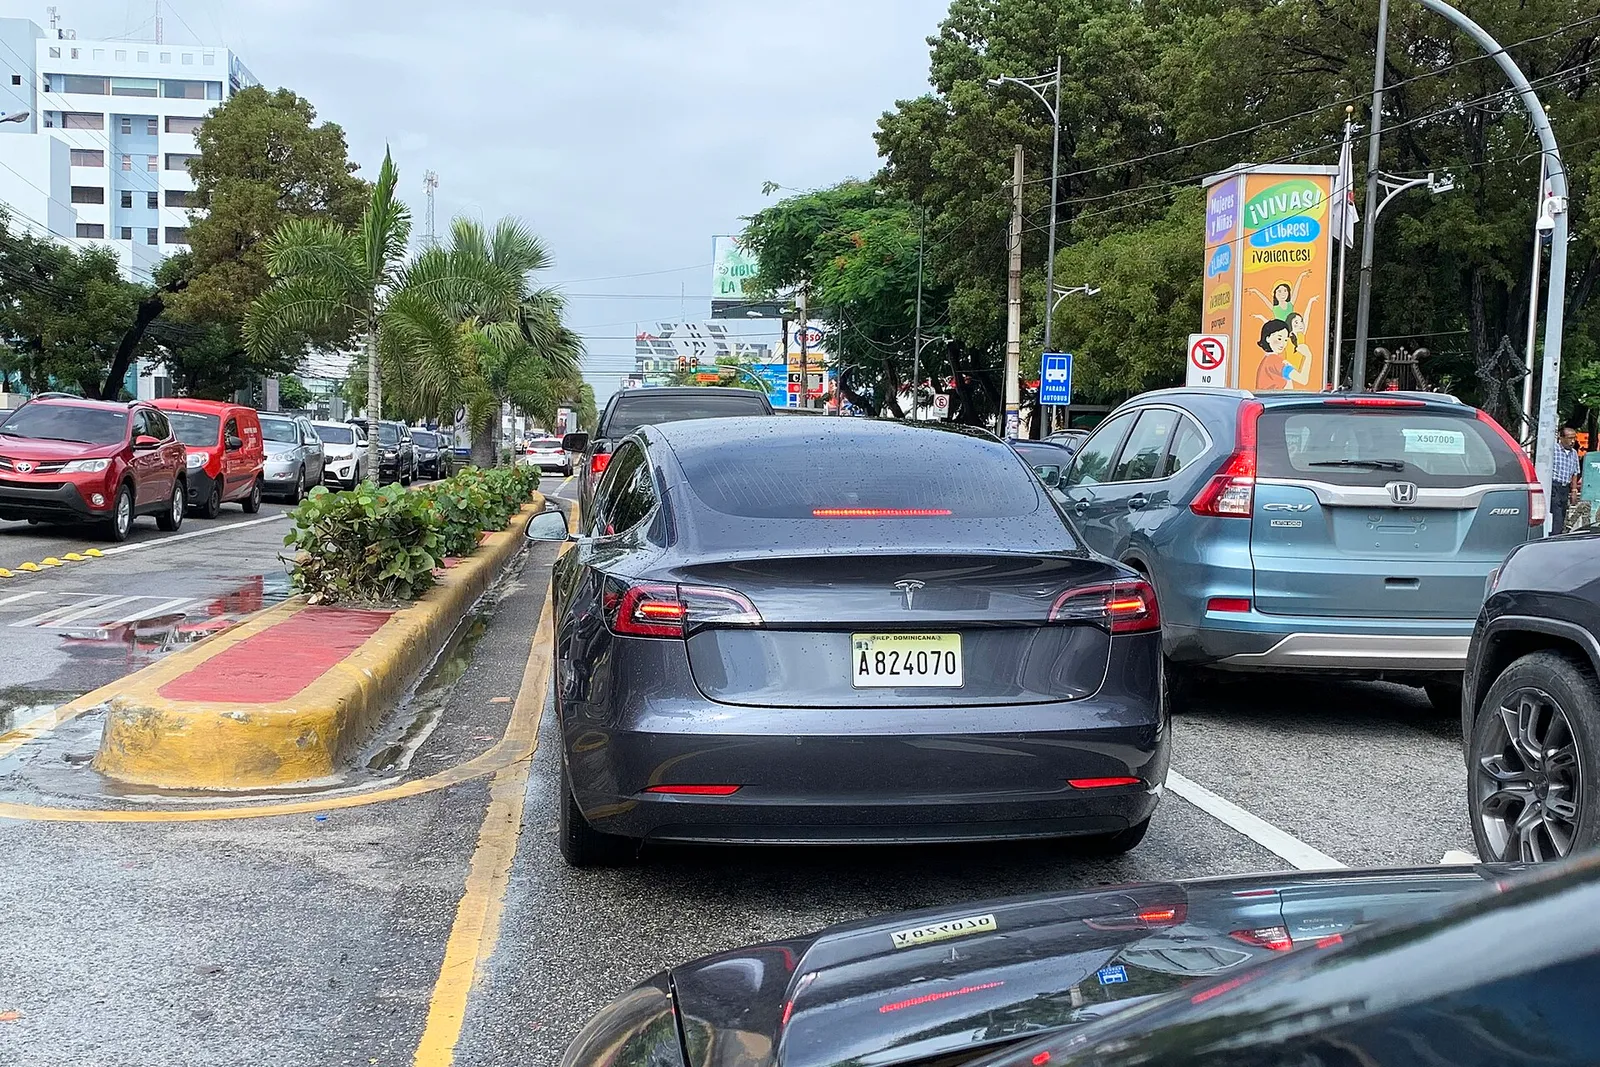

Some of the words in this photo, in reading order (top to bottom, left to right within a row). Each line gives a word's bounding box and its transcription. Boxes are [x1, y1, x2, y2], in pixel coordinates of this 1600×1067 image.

[1211, 193, 1234, 215] Mujeres
[1249, 189, 1321, 225] ¡VIVAS!
[721, 281, 735, 293] LA
[1417, 435, 1455, 443] X507009
[1262, 503, 1313, 512] CR-V
[859, 651, 956, 675] A824070
